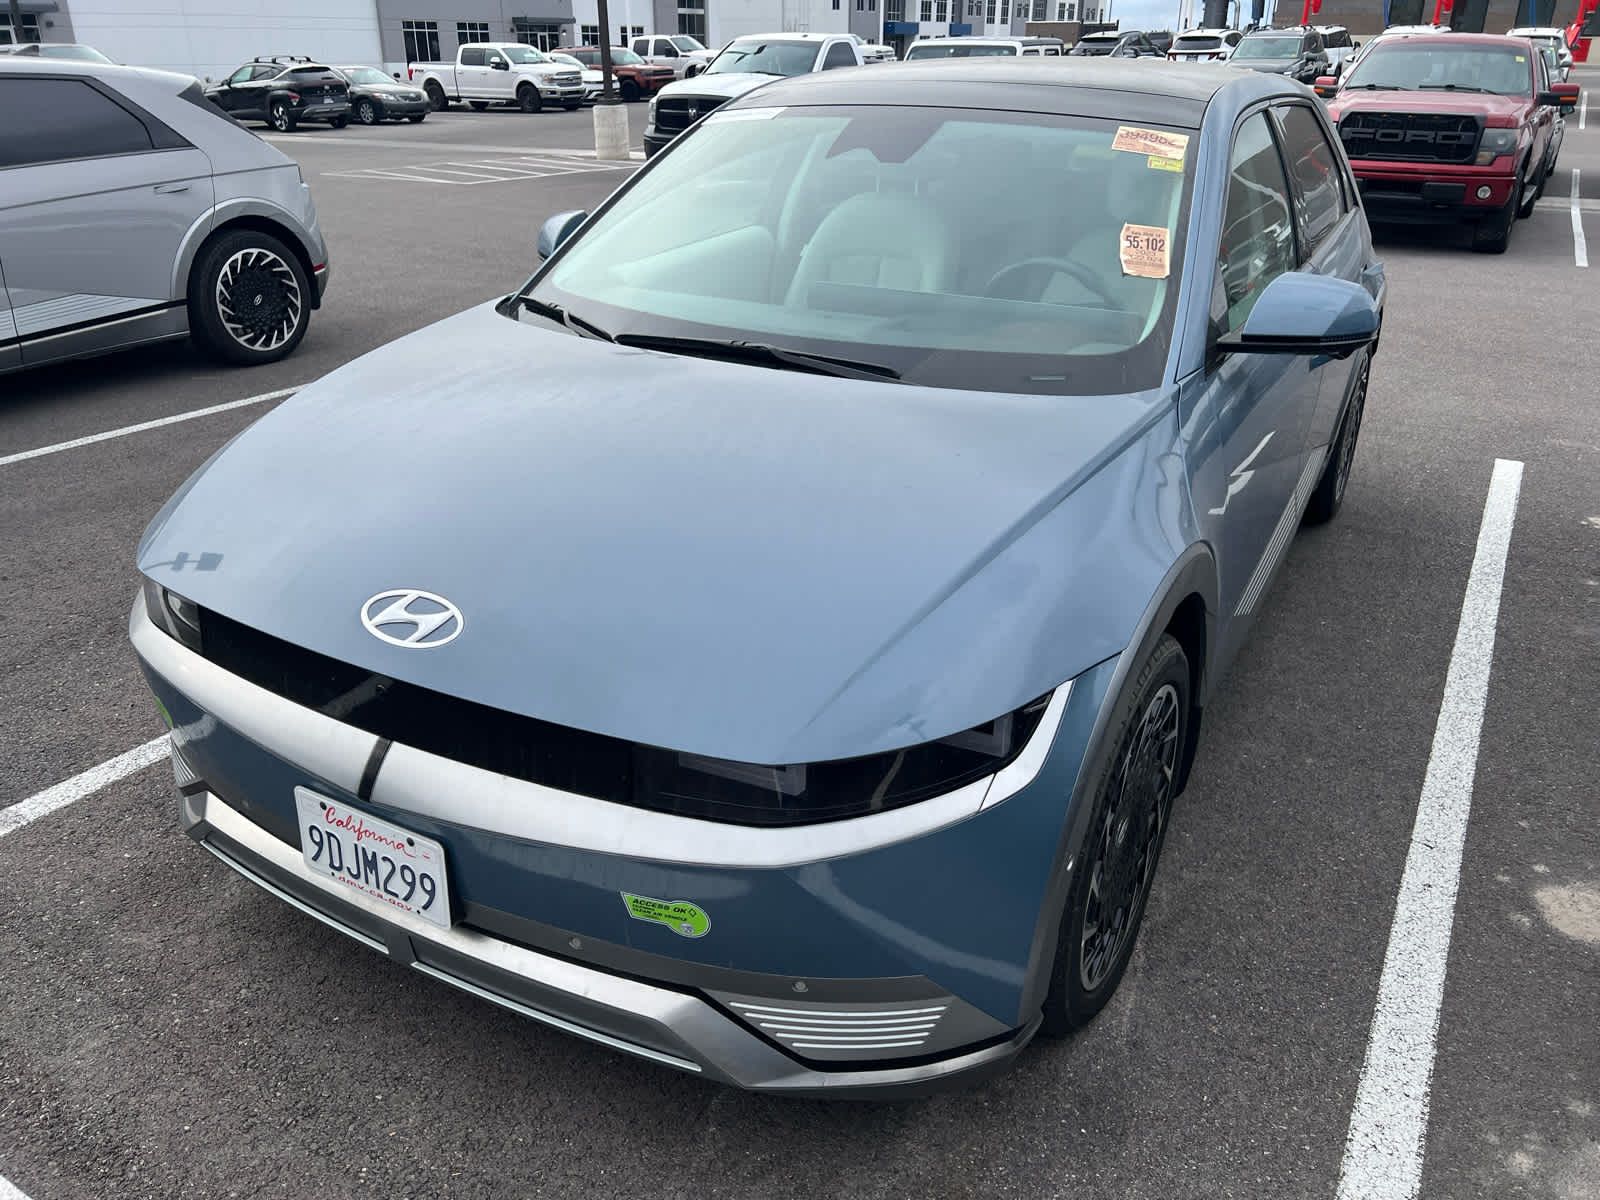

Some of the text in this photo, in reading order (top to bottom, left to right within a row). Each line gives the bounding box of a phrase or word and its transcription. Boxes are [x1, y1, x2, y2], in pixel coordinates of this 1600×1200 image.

[1350, 127, 1464, 144] FORD
[1126, 235, 1165, 252] 55:102
[324, 806, 416, 858] California
[308, 824, 436, 911] 9DJM299
[632, 898, 670, 911] ACCESS
[673, 906, 687, 914] OK
